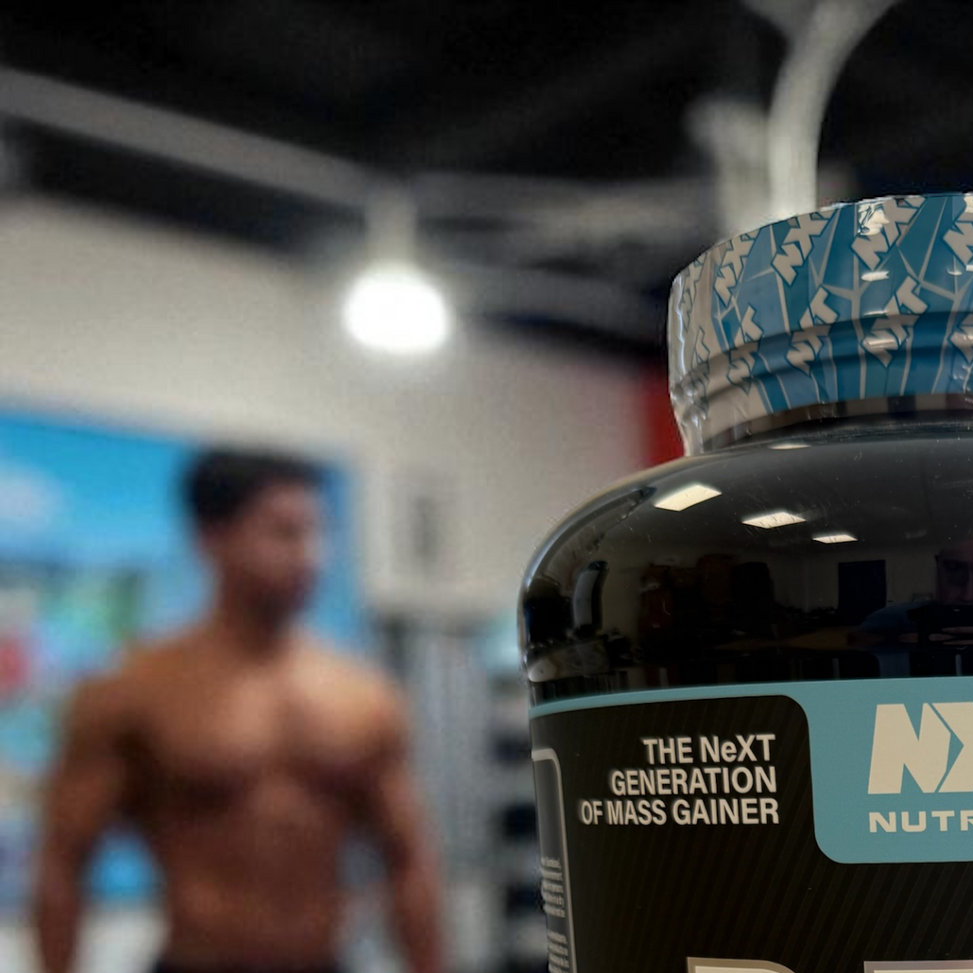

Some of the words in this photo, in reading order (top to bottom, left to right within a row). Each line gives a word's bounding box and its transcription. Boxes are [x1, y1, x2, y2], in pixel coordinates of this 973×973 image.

[861, 275, 930, 368] NXT
[643, 737, 693, 764] THE
[701, 733, 776, 763] NeXT
[611, 766, 777, 797] GENERATION
[581, 800, 603, 825] OF
[607, 799, 667, 825] MASS
[672, 798, 780, 825] GAINER
